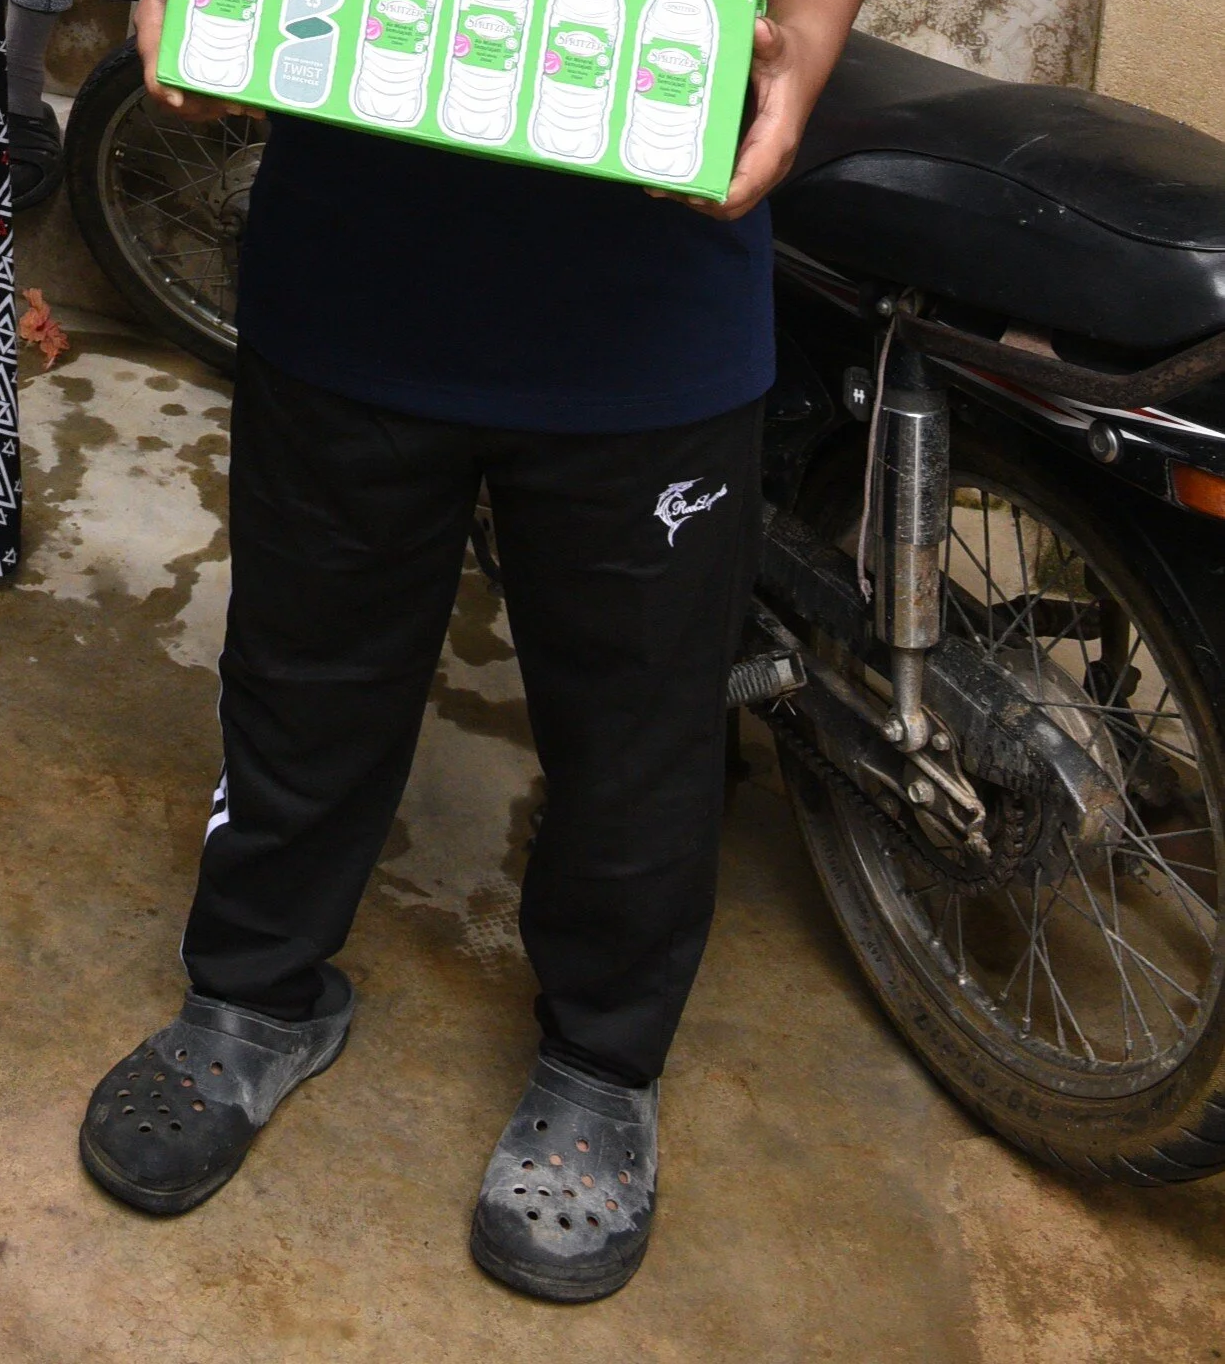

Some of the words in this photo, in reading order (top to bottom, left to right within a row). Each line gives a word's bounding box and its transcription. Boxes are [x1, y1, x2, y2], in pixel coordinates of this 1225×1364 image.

[378, 1, 424, 18] SPRITZER
[467, 18, 513, 35] SPRITZER
[557, 35, 605, 52] SPRITZER
[649, 52, 697, 69] SPRITZER
[283, 62, 323, 79] TWIST
